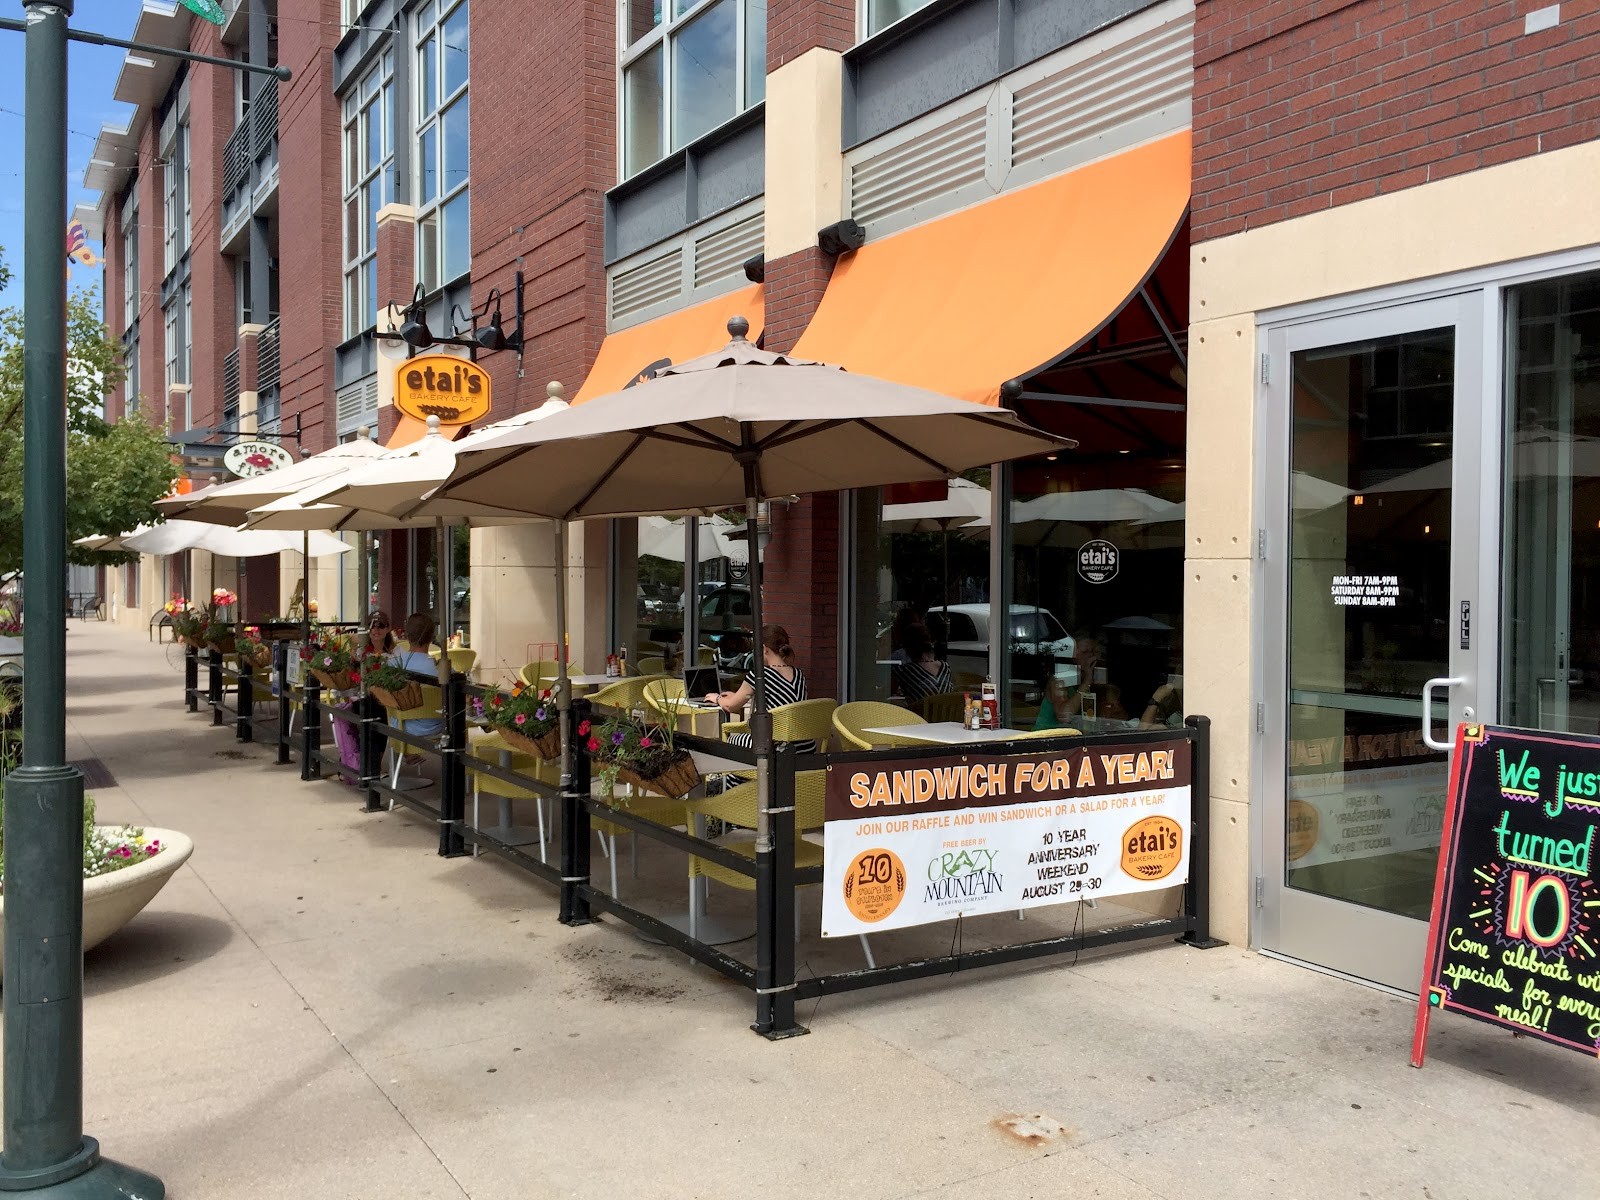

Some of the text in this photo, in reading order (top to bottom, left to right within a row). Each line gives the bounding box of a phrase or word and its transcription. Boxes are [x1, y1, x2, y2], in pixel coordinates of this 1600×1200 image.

[406, 365, 482, 394] etai's
[409, 393, 478, 403] BAKERY CAFE
[233, 444, 285, 460] amore
[1081, 546, 1116, 565] etai's
[1331, 586, 1400, 596] SATURDAY 8AM-9PM
[1332, 575, 1398, 586] MON-FRI 7AM-9PM
[1334, 596, 1396, 606] SUNDAY 8AM-8PM
[1461, 604, 1469, 639] PULL
[850, 750, 1175, 808] SANDWICH FOR A YEAR!
[1498, 749, 1541, 790] We
[856, 794, 1166, 837] JOIN OUR RAFFLE AND WIN SANDWICH OR A SALAD FOR A YEAR!
[943, 838, 986, 849] FREE BEER BY
[1042, 828, 1087, 846] 10 YEAR
[1127, 826, 1177, 855] etai's
[1494, 810, 1595, 873] turned
[927, 849, 999, 882] CRAZY
[1027, 843, 1100, 866] ANNIVERSARY
[1128, 852, 1175, 864] BAKERY CAFE
[858, 853, 892, 886] 10
[1037, 862, 1089, 881] WEEKEND
[923, 867, 1003, 903] MOUNTAIN
[1022, 881, 1066, 900] AUGUST
[937, 895, 988, 907] BREWING COMPANY
[1505, 870, 1570, 947] 10
[1448, 927, 1490, 959] Come
[1502, 944, 1572, 981] celebrate
[1443, 963, 1513, 993] specials
[1522, 978, 1552, 1011] for
[1495, 1004, 1552, 1032] meal!
